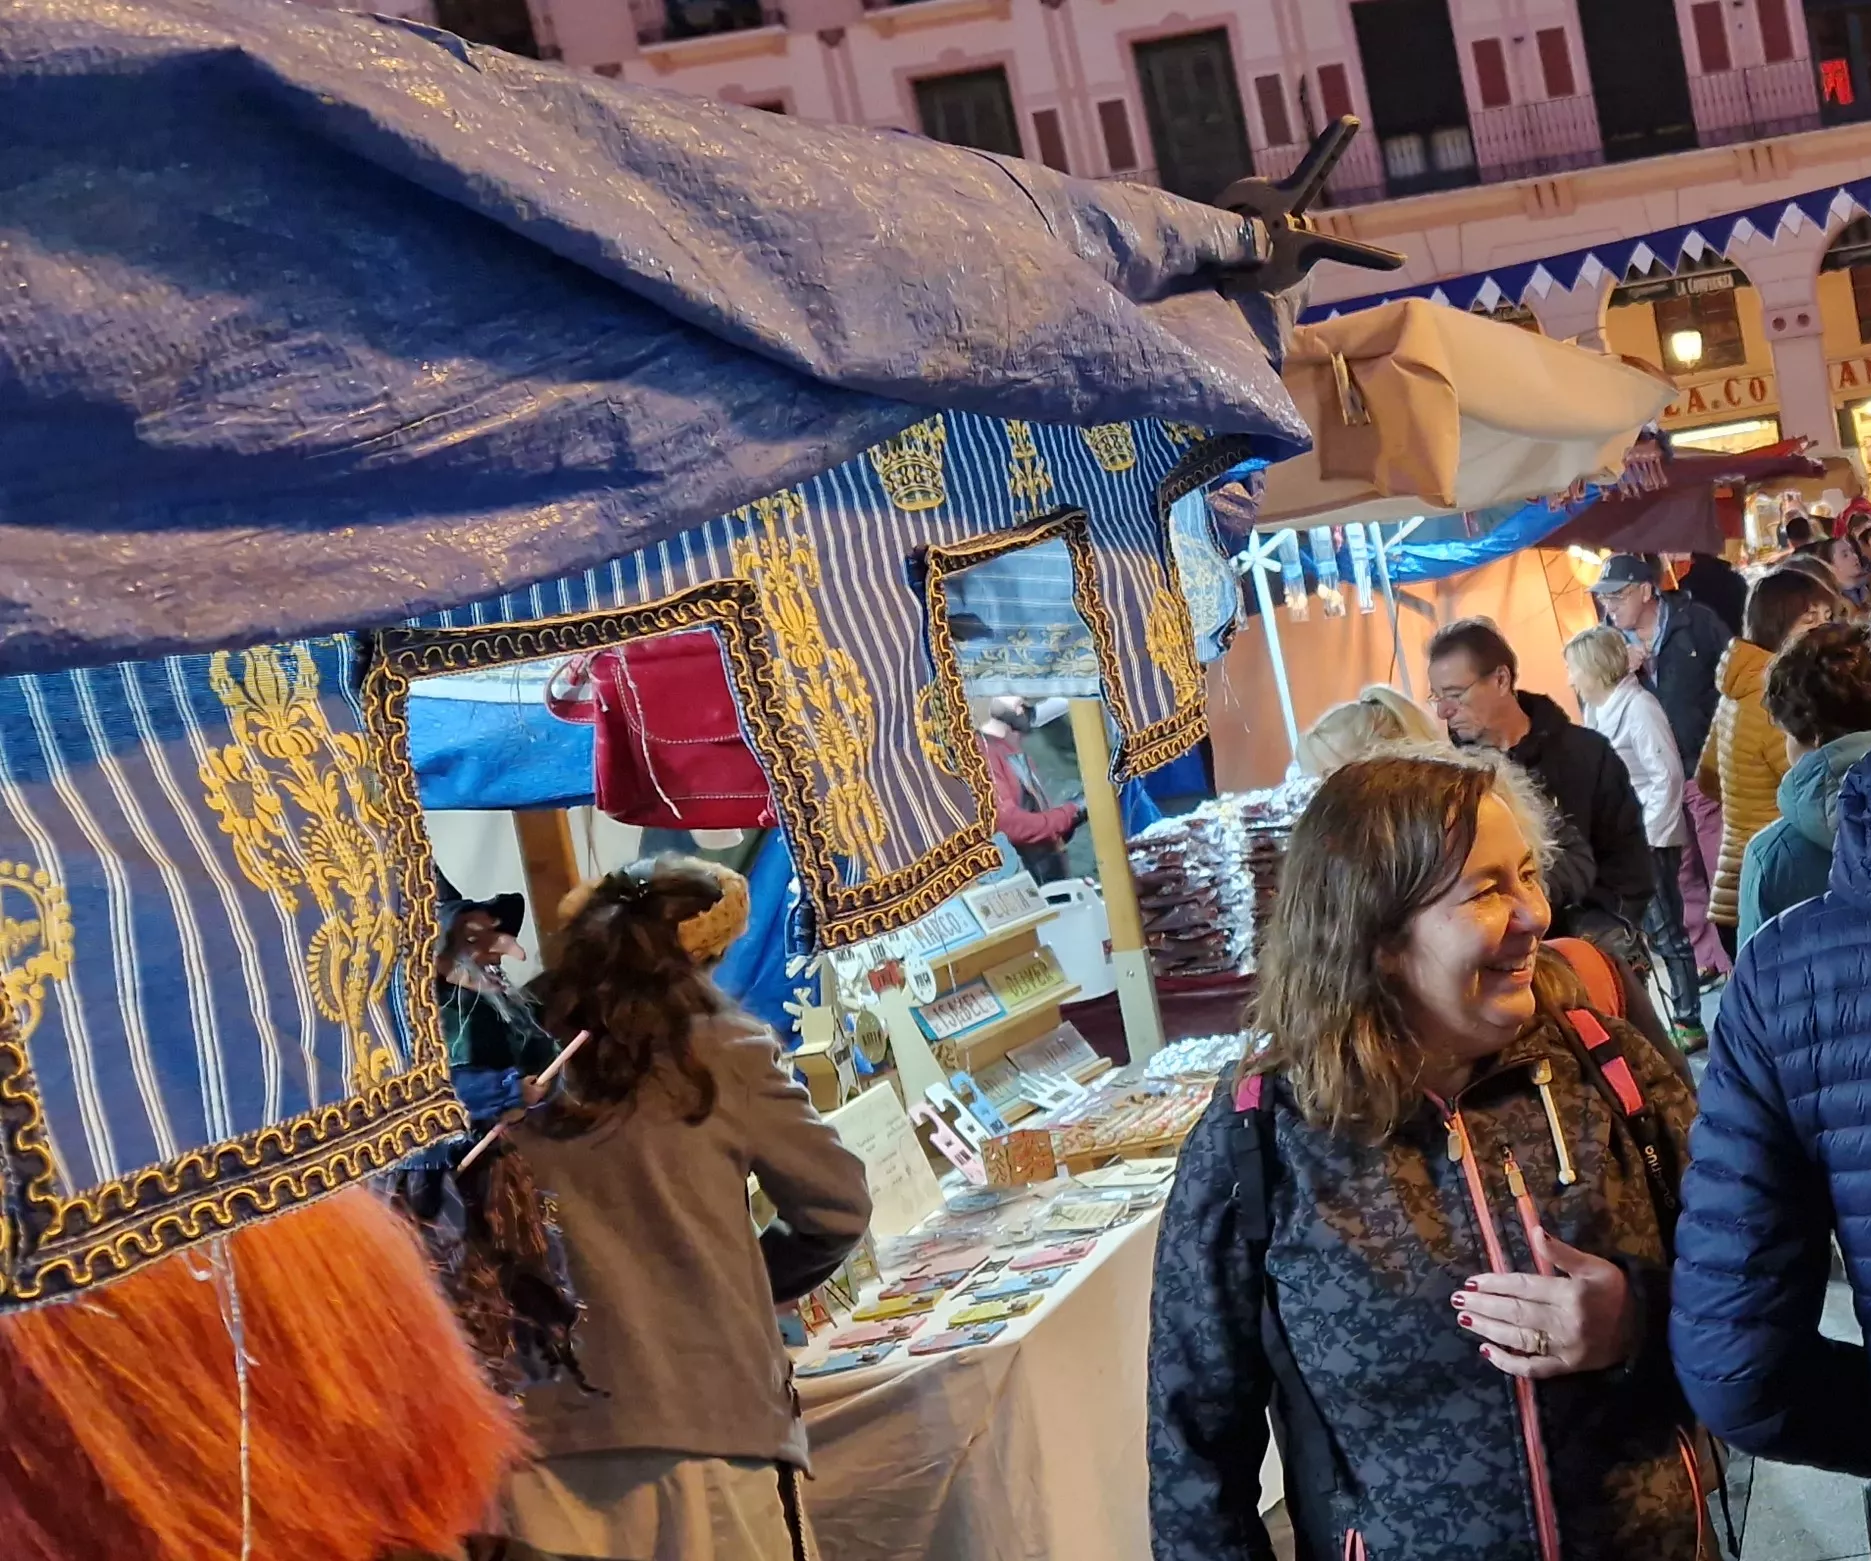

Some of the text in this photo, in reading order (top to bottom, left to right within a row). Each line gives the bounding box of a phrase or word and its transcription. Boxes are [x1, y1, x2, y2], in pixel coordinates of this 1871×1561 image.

[909, 911, 963, 949] MARCO
[1004, 959, 1055, 997] OLIVER
[933, 991, 989, 1031] ISABEL
